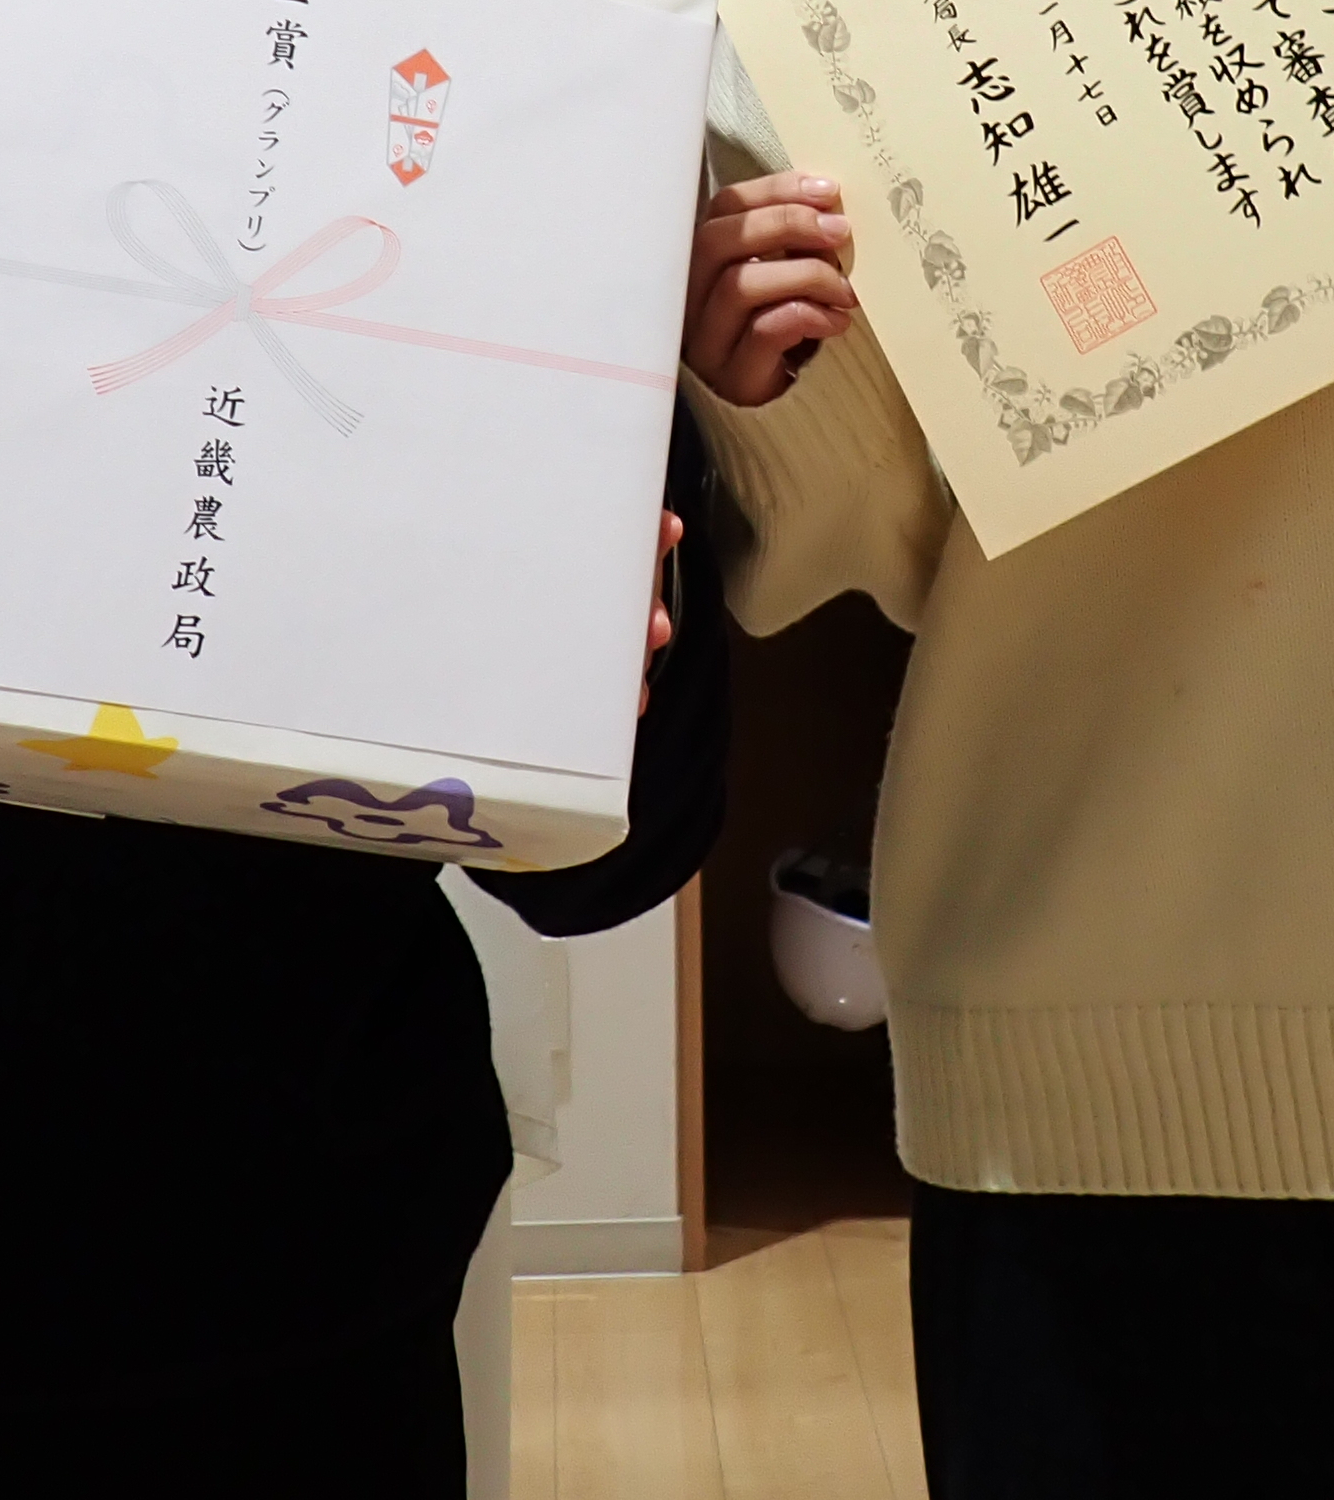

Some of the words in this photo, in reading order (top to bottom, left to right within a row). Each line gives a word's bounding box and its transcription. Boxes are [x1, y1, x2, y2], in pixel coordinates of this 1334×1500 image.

[162, 385, 246, 660] 近畿農政局
